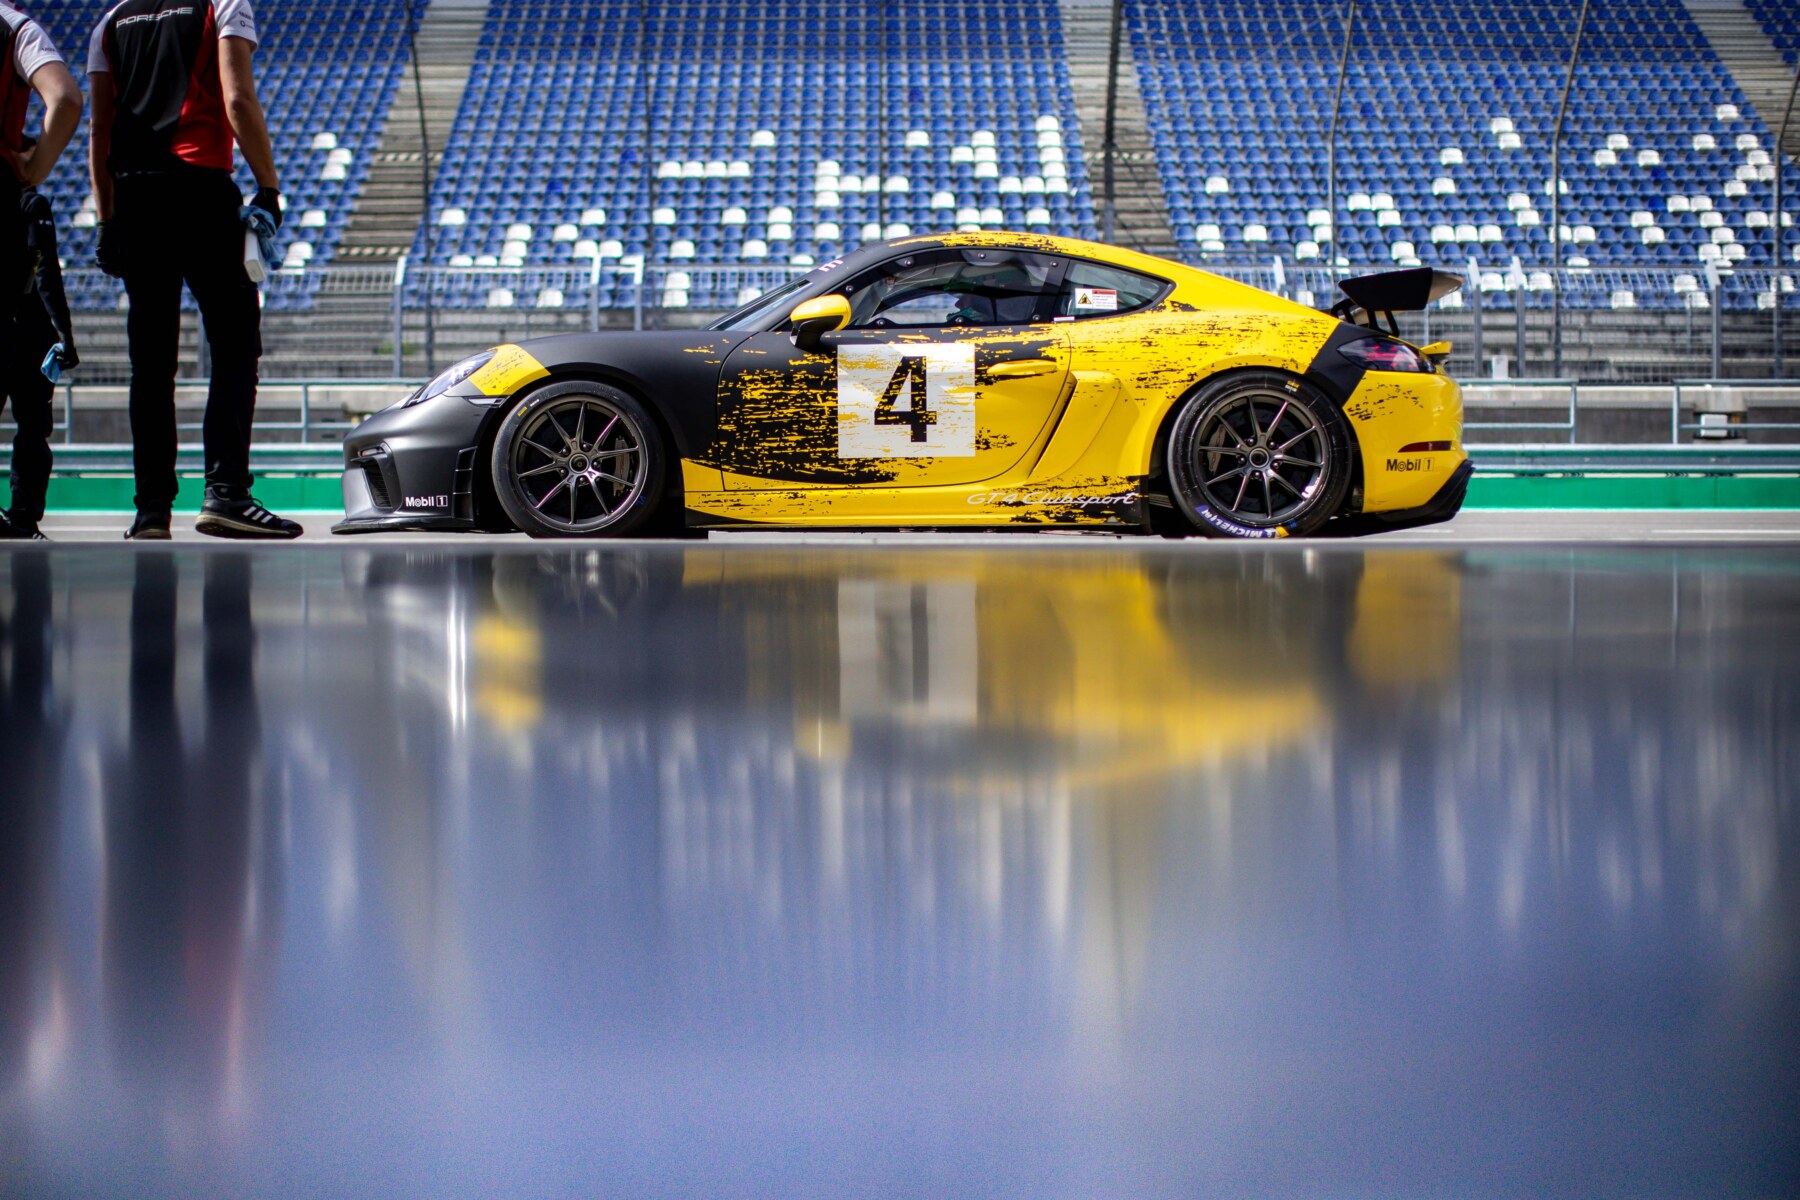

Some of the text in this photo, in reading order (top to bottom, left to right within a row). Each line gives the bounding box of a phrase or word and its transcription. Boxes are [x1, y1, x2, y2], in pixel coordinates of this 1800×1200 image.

[116, 7, 193, 28] PORSCHE
[874, 356, 937, 442] 4
[1386, 459, 1421, 472] Mobil
[405, 496, 434, 507] Mobil
[967, 492, 1139, 508] GT4 Clubsport
[1201, 509, 1263, 538] MICHELIN
